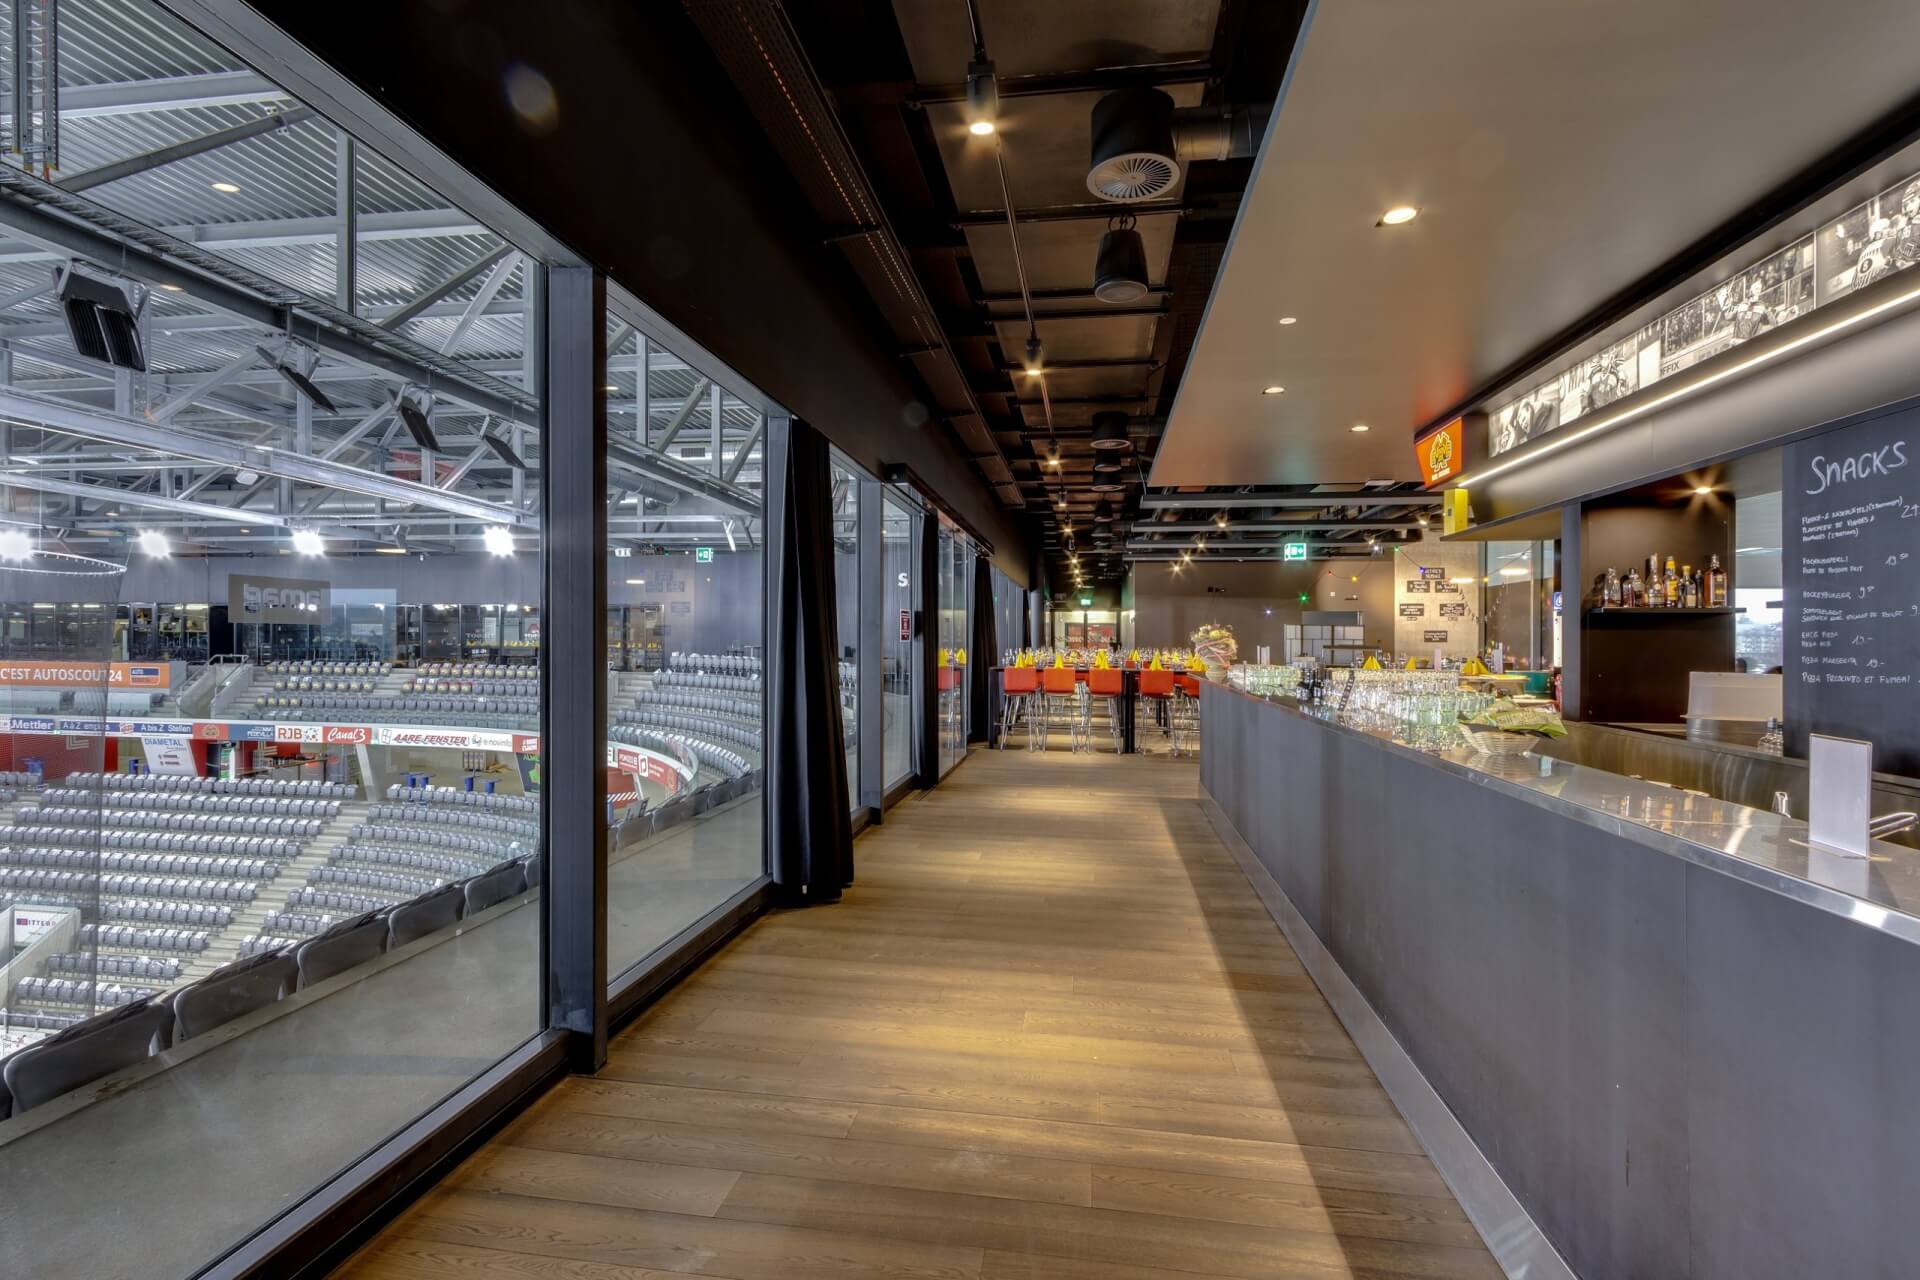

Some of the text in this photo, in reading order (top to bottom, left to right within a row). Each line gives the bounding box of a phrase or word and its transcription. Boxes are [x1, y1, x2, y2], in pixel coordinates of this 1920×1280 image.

[1, 667, 30, 681] C'EST
[33, 668, 123, 682] AUTOSCOUT24
[278, 728, 302, 740] RJB
